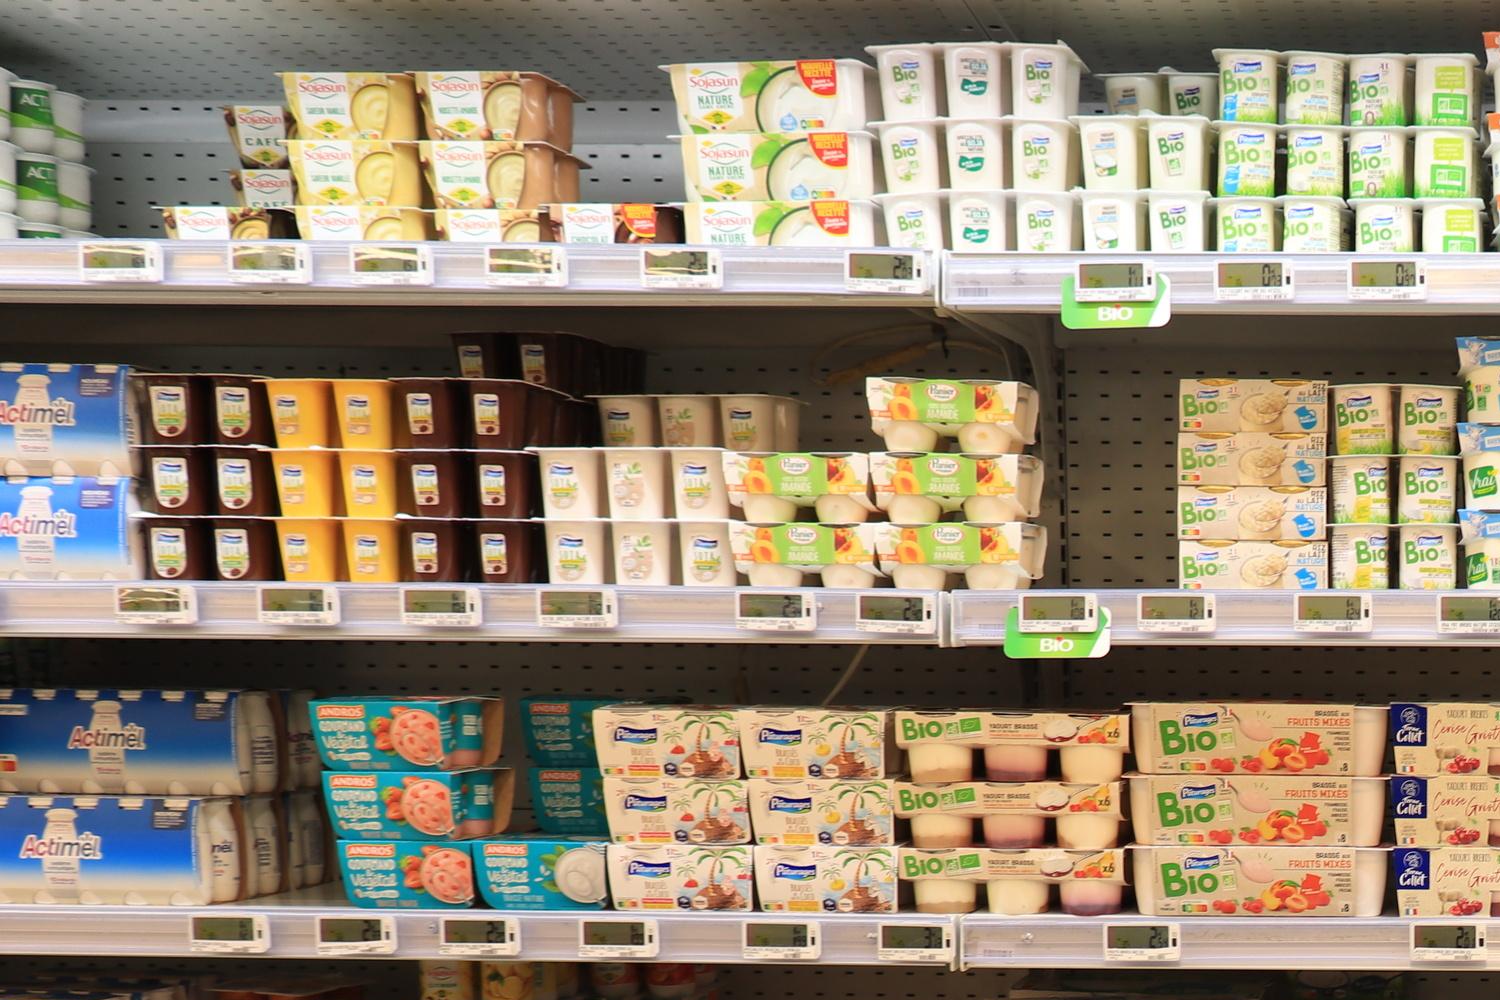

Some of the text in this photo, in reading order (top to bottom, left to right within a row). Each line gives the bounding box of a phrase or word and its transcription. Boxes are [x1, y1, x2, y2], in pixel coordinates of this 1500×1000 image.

[689, 76, 738, 89] Sojasun
[698, 96, 733, 106] NATURE
[701, 148, 749, 161] Sojasun
[708, 166, 744, 177] NATURE
[703, 215, 751, 228] Sojasun
[320, 706, 362, 717] ANDROS
[1288, 718, 1318, 726] FRUITS
[69, 722, 144, 749] Actimel
[333, 776, 375, 788] ANDROS
[1285, 790, 1315, 798] FRUITS
[20, 831, 101, 859] Actimel
[348, 845, 393, 856] ANDROS
[488, 845, 526, 855] ANDROS
[1289, 860, 1318, 868] FRUITS
